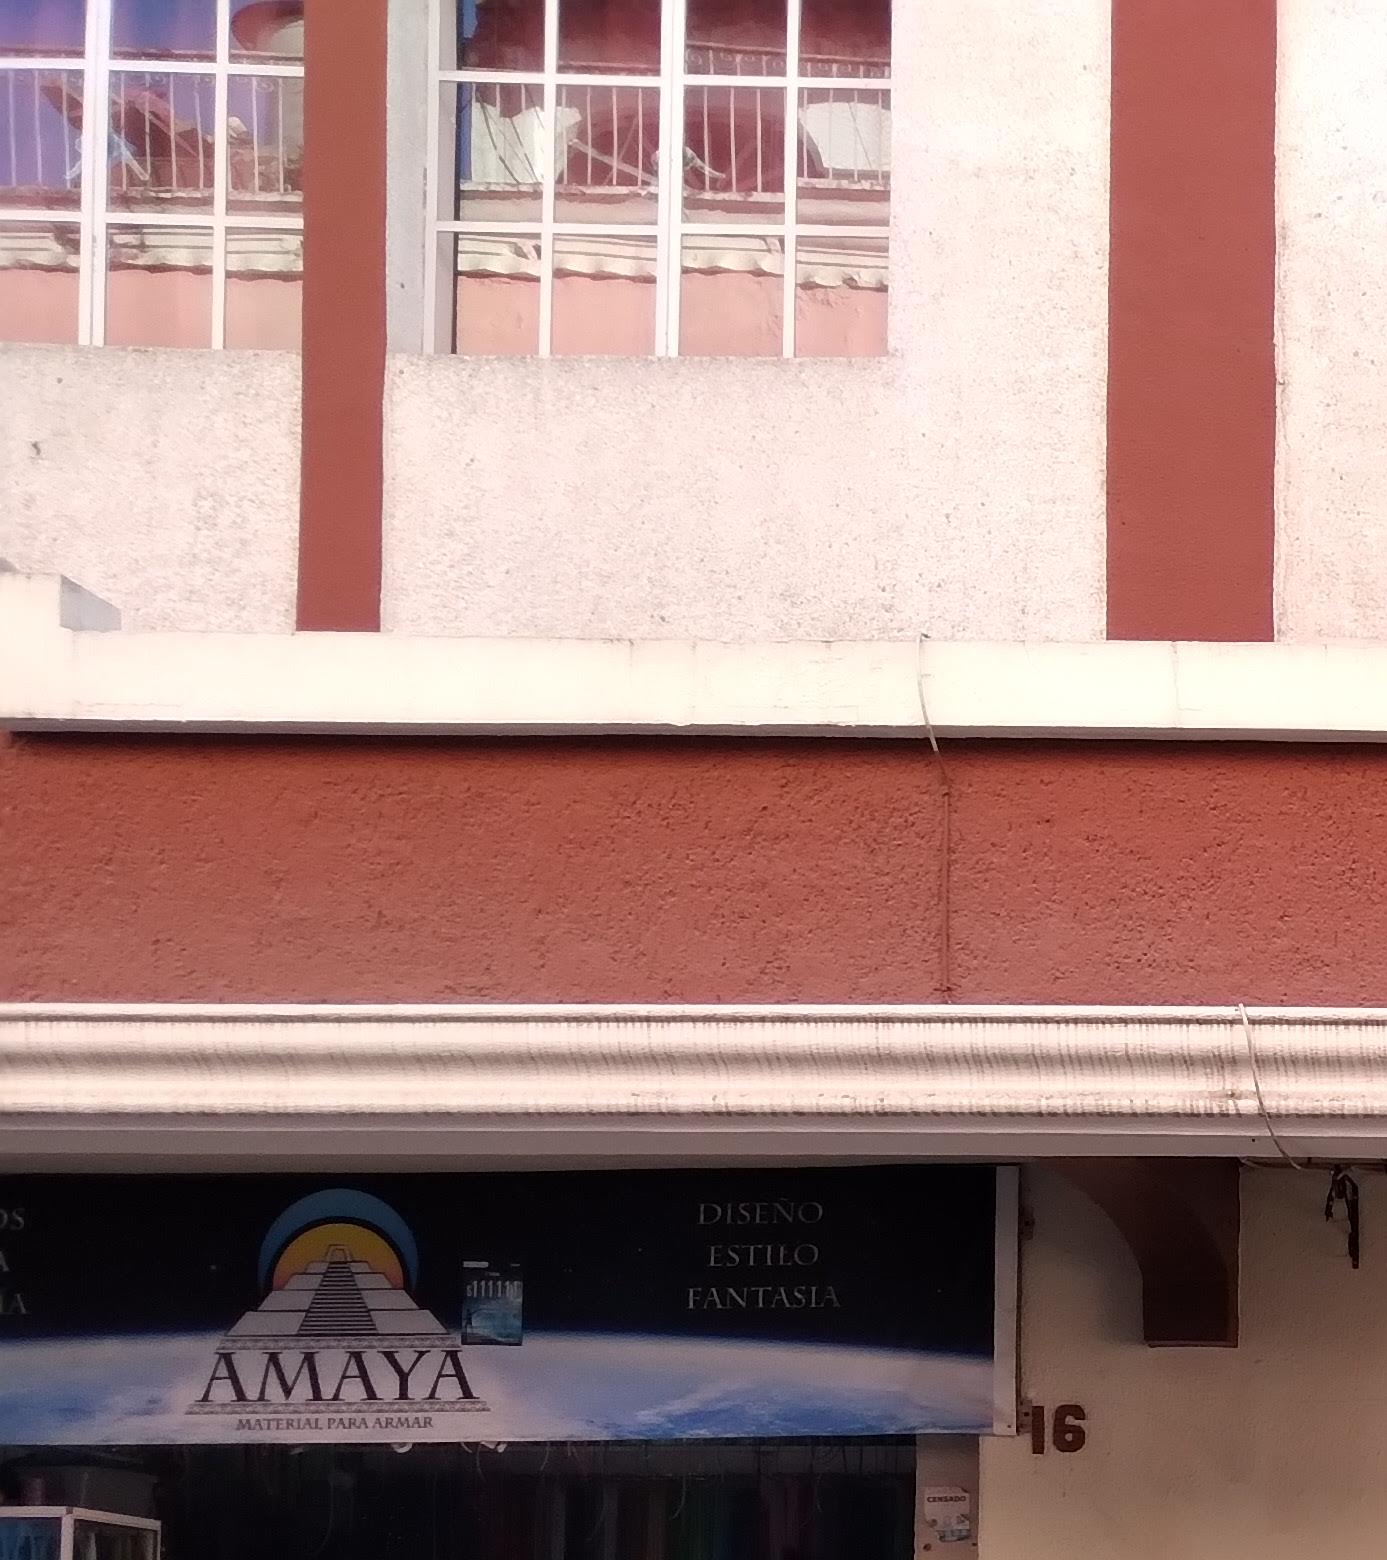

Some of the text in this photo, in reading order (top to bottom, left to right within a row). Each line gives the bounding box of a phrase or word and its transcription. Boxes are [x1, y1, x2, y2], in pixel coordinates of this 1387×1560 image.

[697, 1198, 824, 1225] DISEÑO
[708, 1243, 820, 1268] ESTILO
[686, 1285, 841, 1310] FANTASIA
[195, 1350, 481, 1403] AMAYA
[236, 1416, 433, 1431] MATERIAL PARA ARMAR
[1032, 1404, 1086, 1455] 16
